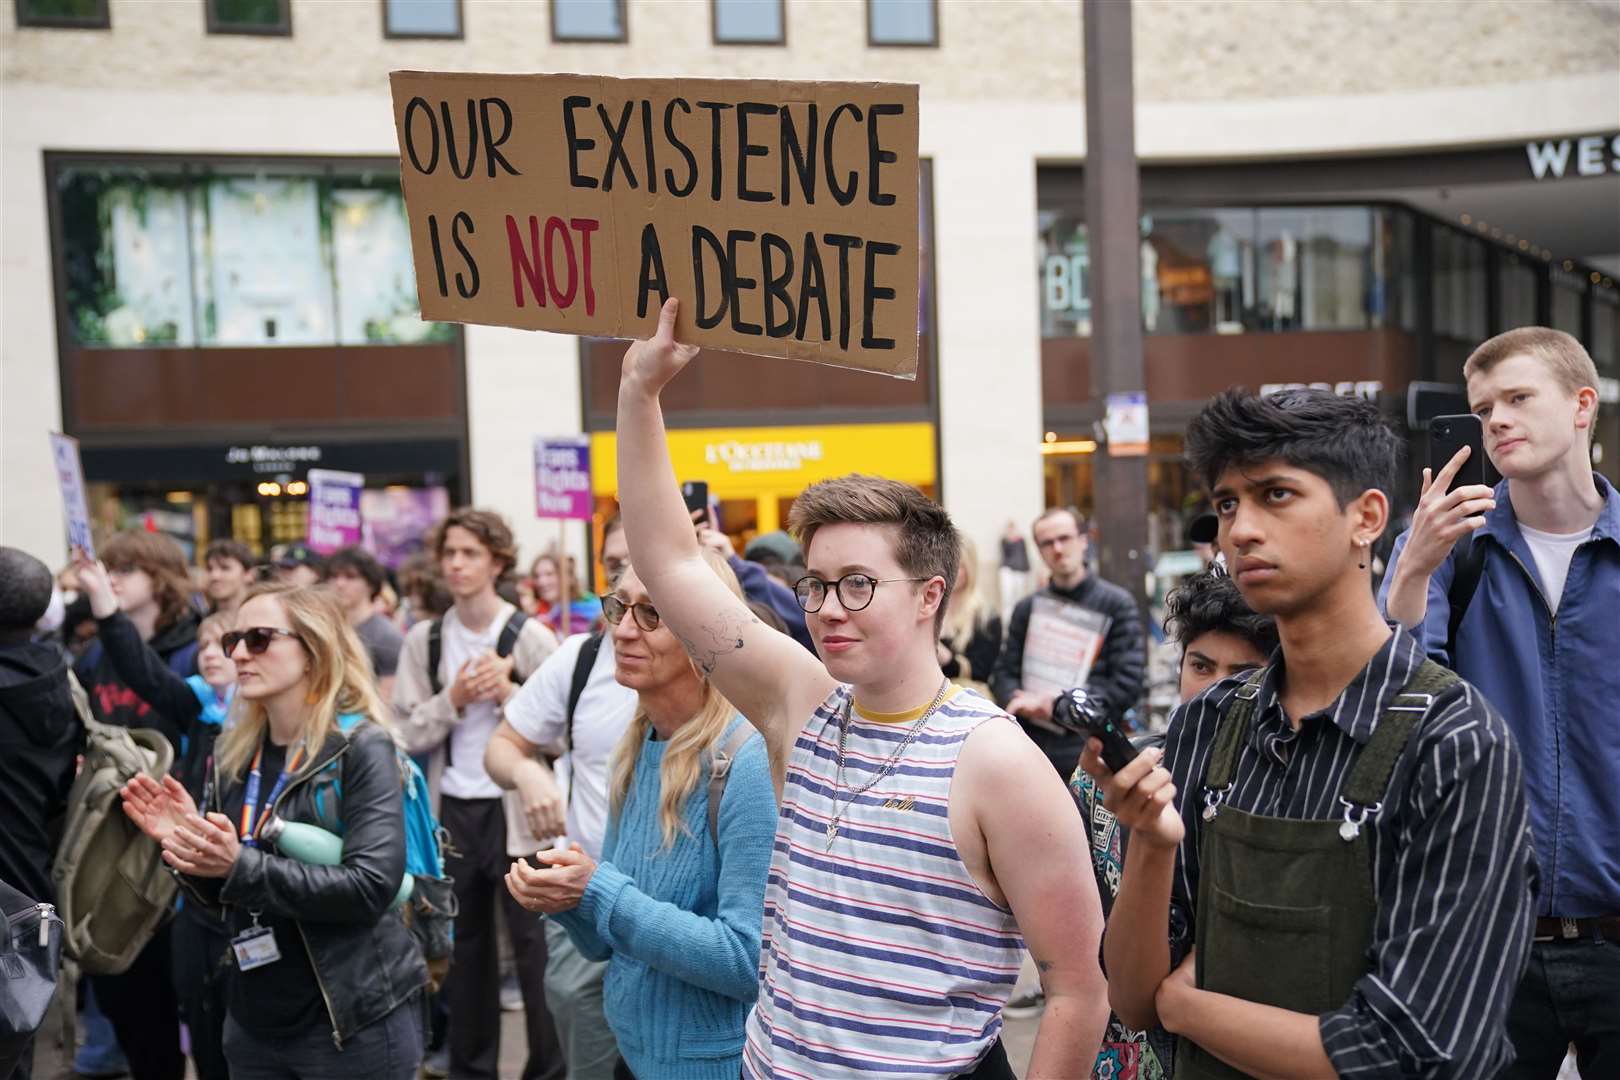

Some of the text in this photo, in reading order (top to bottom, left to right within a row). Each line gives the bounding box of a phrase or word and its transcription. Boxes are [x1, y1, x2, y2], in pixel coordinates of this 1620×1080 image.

[404, 96, 904, 206] OUR EXISTENCE
[428, 211, 901, 351] IS NOT A DEBATE
